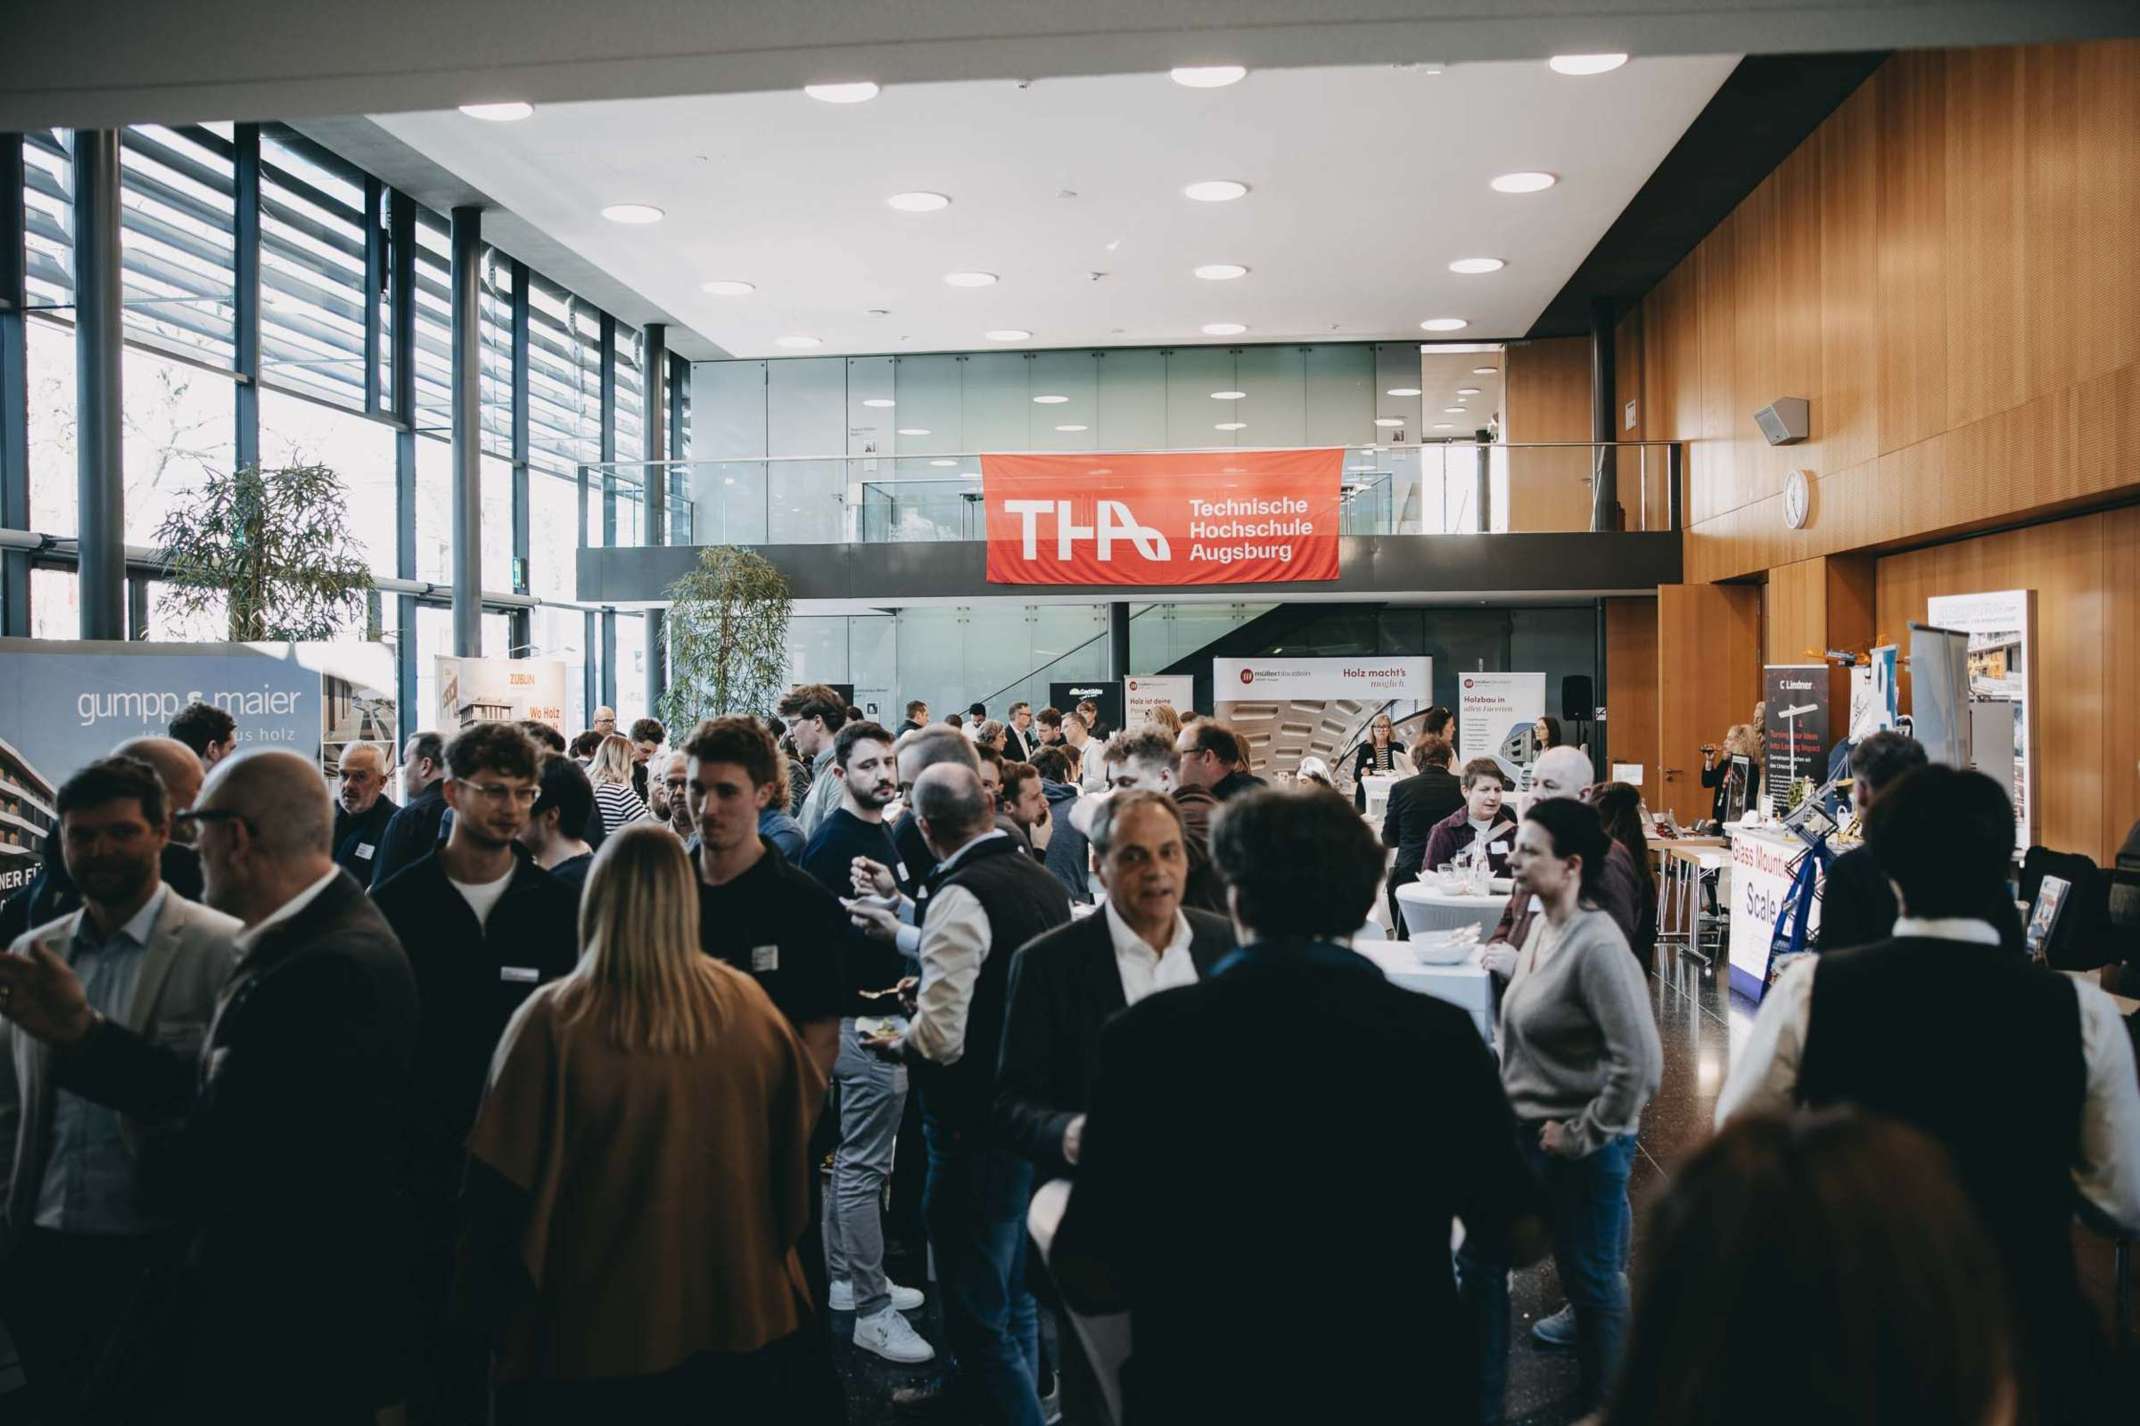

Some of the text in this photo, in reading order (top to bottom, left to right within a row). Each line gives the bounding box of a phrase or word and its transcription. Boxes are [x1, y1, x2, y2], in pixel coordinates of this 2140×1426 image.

[1189, 497, 1308, 518] Technische
[1189, 519, 1313, 540] Hochschule
[1189, 542, 1292, 564] Augsburg
[1343, 667, 1406, 678] Holz macht's
[1786, 680, 1813, 690] Lindner
[77, 692, 179, 726] gumpp
[214, 684, 301, 715] maier
[259, 728, 295, 742] holz
[1732, 836, 1795, 881] Glass Mounti
[1746, 881, 1777, 926] Scale
